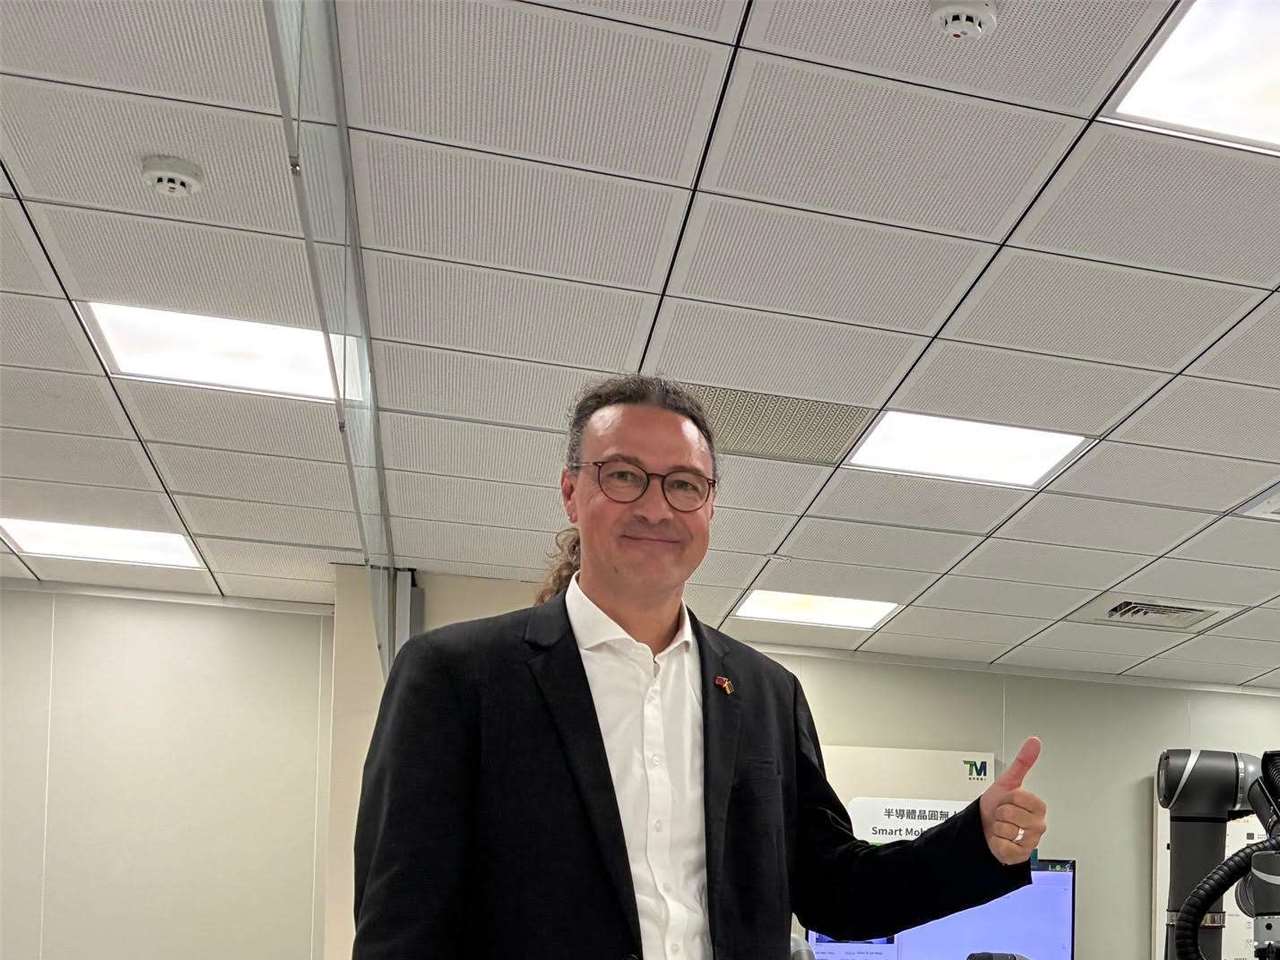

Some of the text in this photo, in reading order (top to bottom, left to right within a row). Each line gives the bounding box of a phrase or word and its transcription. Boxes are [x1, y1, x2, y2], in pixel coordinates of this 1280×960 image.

[884, 808, 957, 821] 半導體晶圓無
[871, 826, 903, 837] Smart
